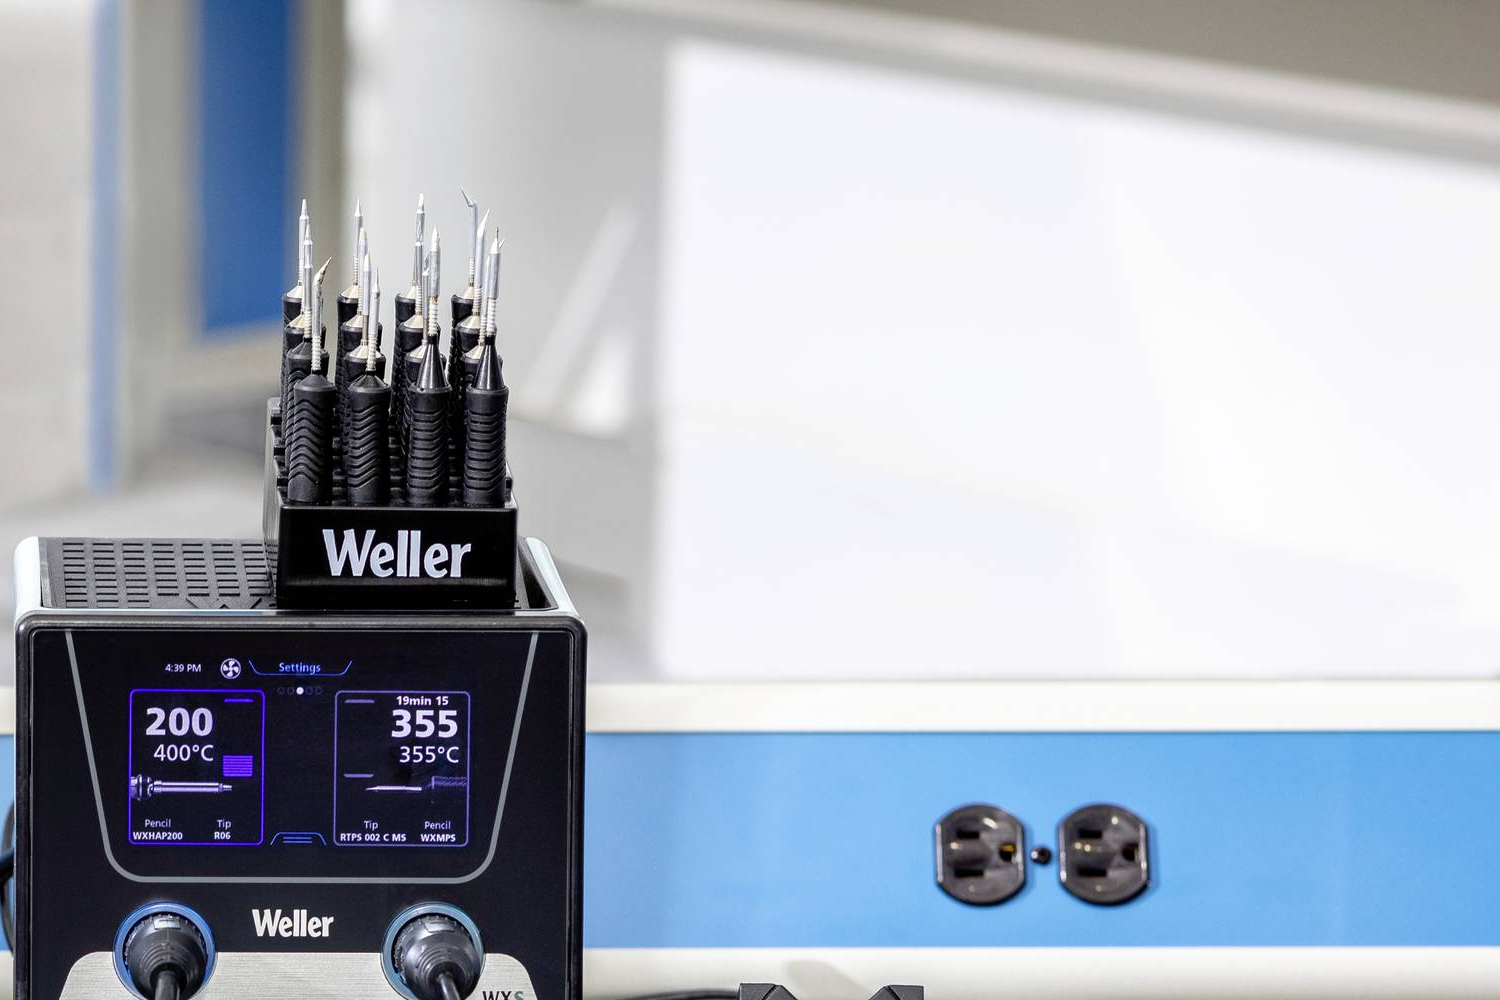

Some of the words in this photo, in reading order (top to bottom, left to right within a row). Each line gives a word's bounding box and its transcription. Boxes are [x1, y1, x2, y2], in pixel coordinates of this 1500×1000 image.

[322, 528, 472, 579] Weller
[164, 663, 185, 673] 4:39
[186, 663, 202, 673] PM
[278, 662, 321, 675] Settings
[396, 695, 432, 706] 19min
[435, 695, 449, 706] 15
[145, 707, 214, 737] 200
[391, 709, 458, 738] 355
[153, 743, 214, 762] 400°C
[399, 745, 460, 764] 355°C
[144, 818, 172, 828] Pencil
[216, 818, 232, 831] Tip
[363, 819, 379, 831] Tip
[424, 820, 452, 830] Pencil
[132, 831, 183, 841] WXHAP200
[214, 831, 232, 841] R06
[339, 832, 362, 842] RTPS
[364, 832, 380, 842] 002
[382, 832, 390, 842] C
[391, 832, 407, 842] MS
[420, 833, 456, 843] WXMPS
[251, 909, 334, 938] Weller
